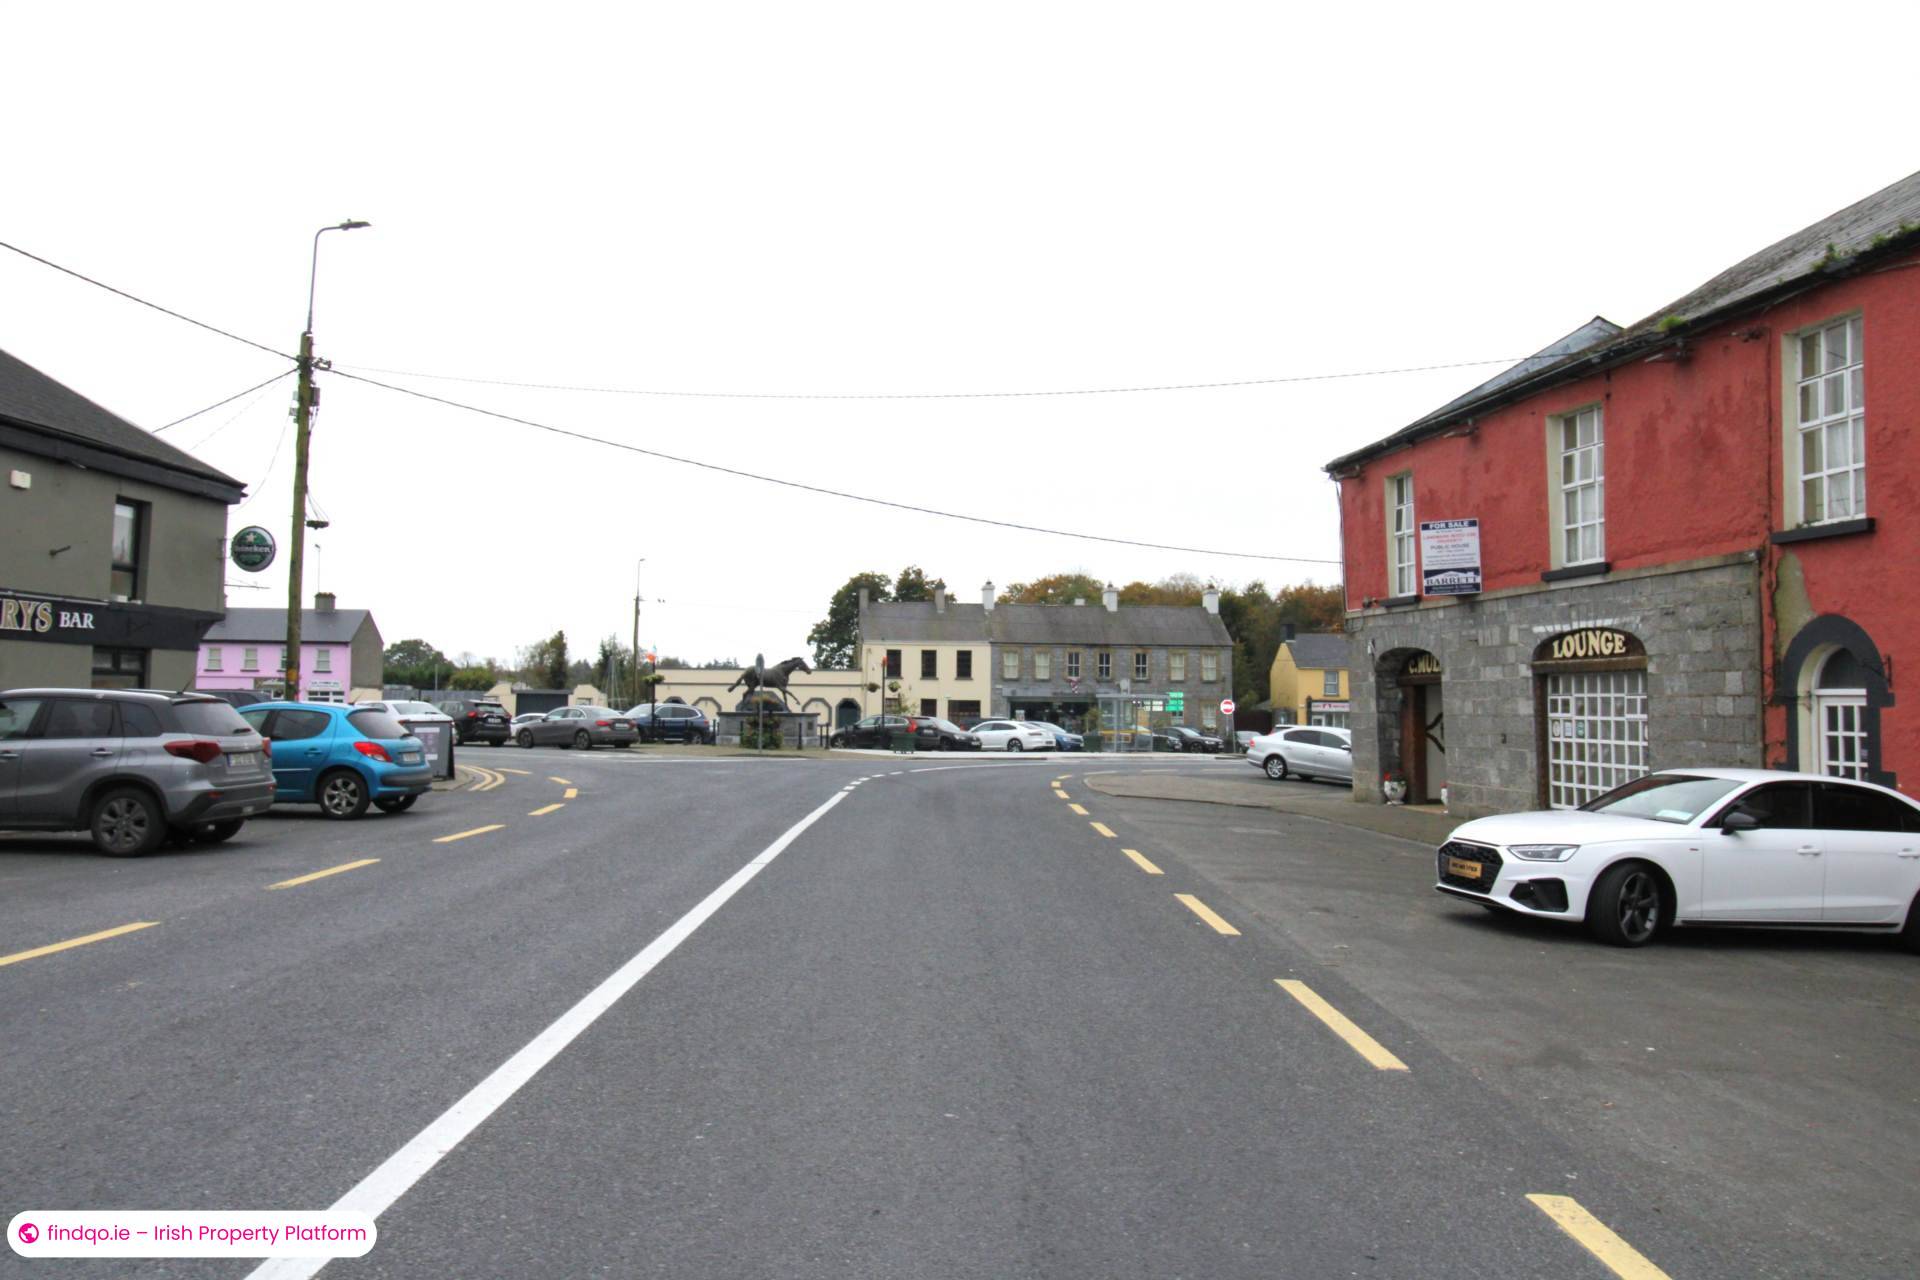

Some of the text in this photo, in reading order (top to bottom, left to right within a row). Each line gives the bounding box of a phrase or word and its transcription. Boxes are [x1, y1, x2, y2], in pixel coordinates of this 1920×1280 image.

[1429, 522, 1446, 530] FOR
[1426, 576, 1477, 585] BARRETT
[59, 611, 95, 629] BAR
[1552, 630, 1627, 658] LOUNGE
